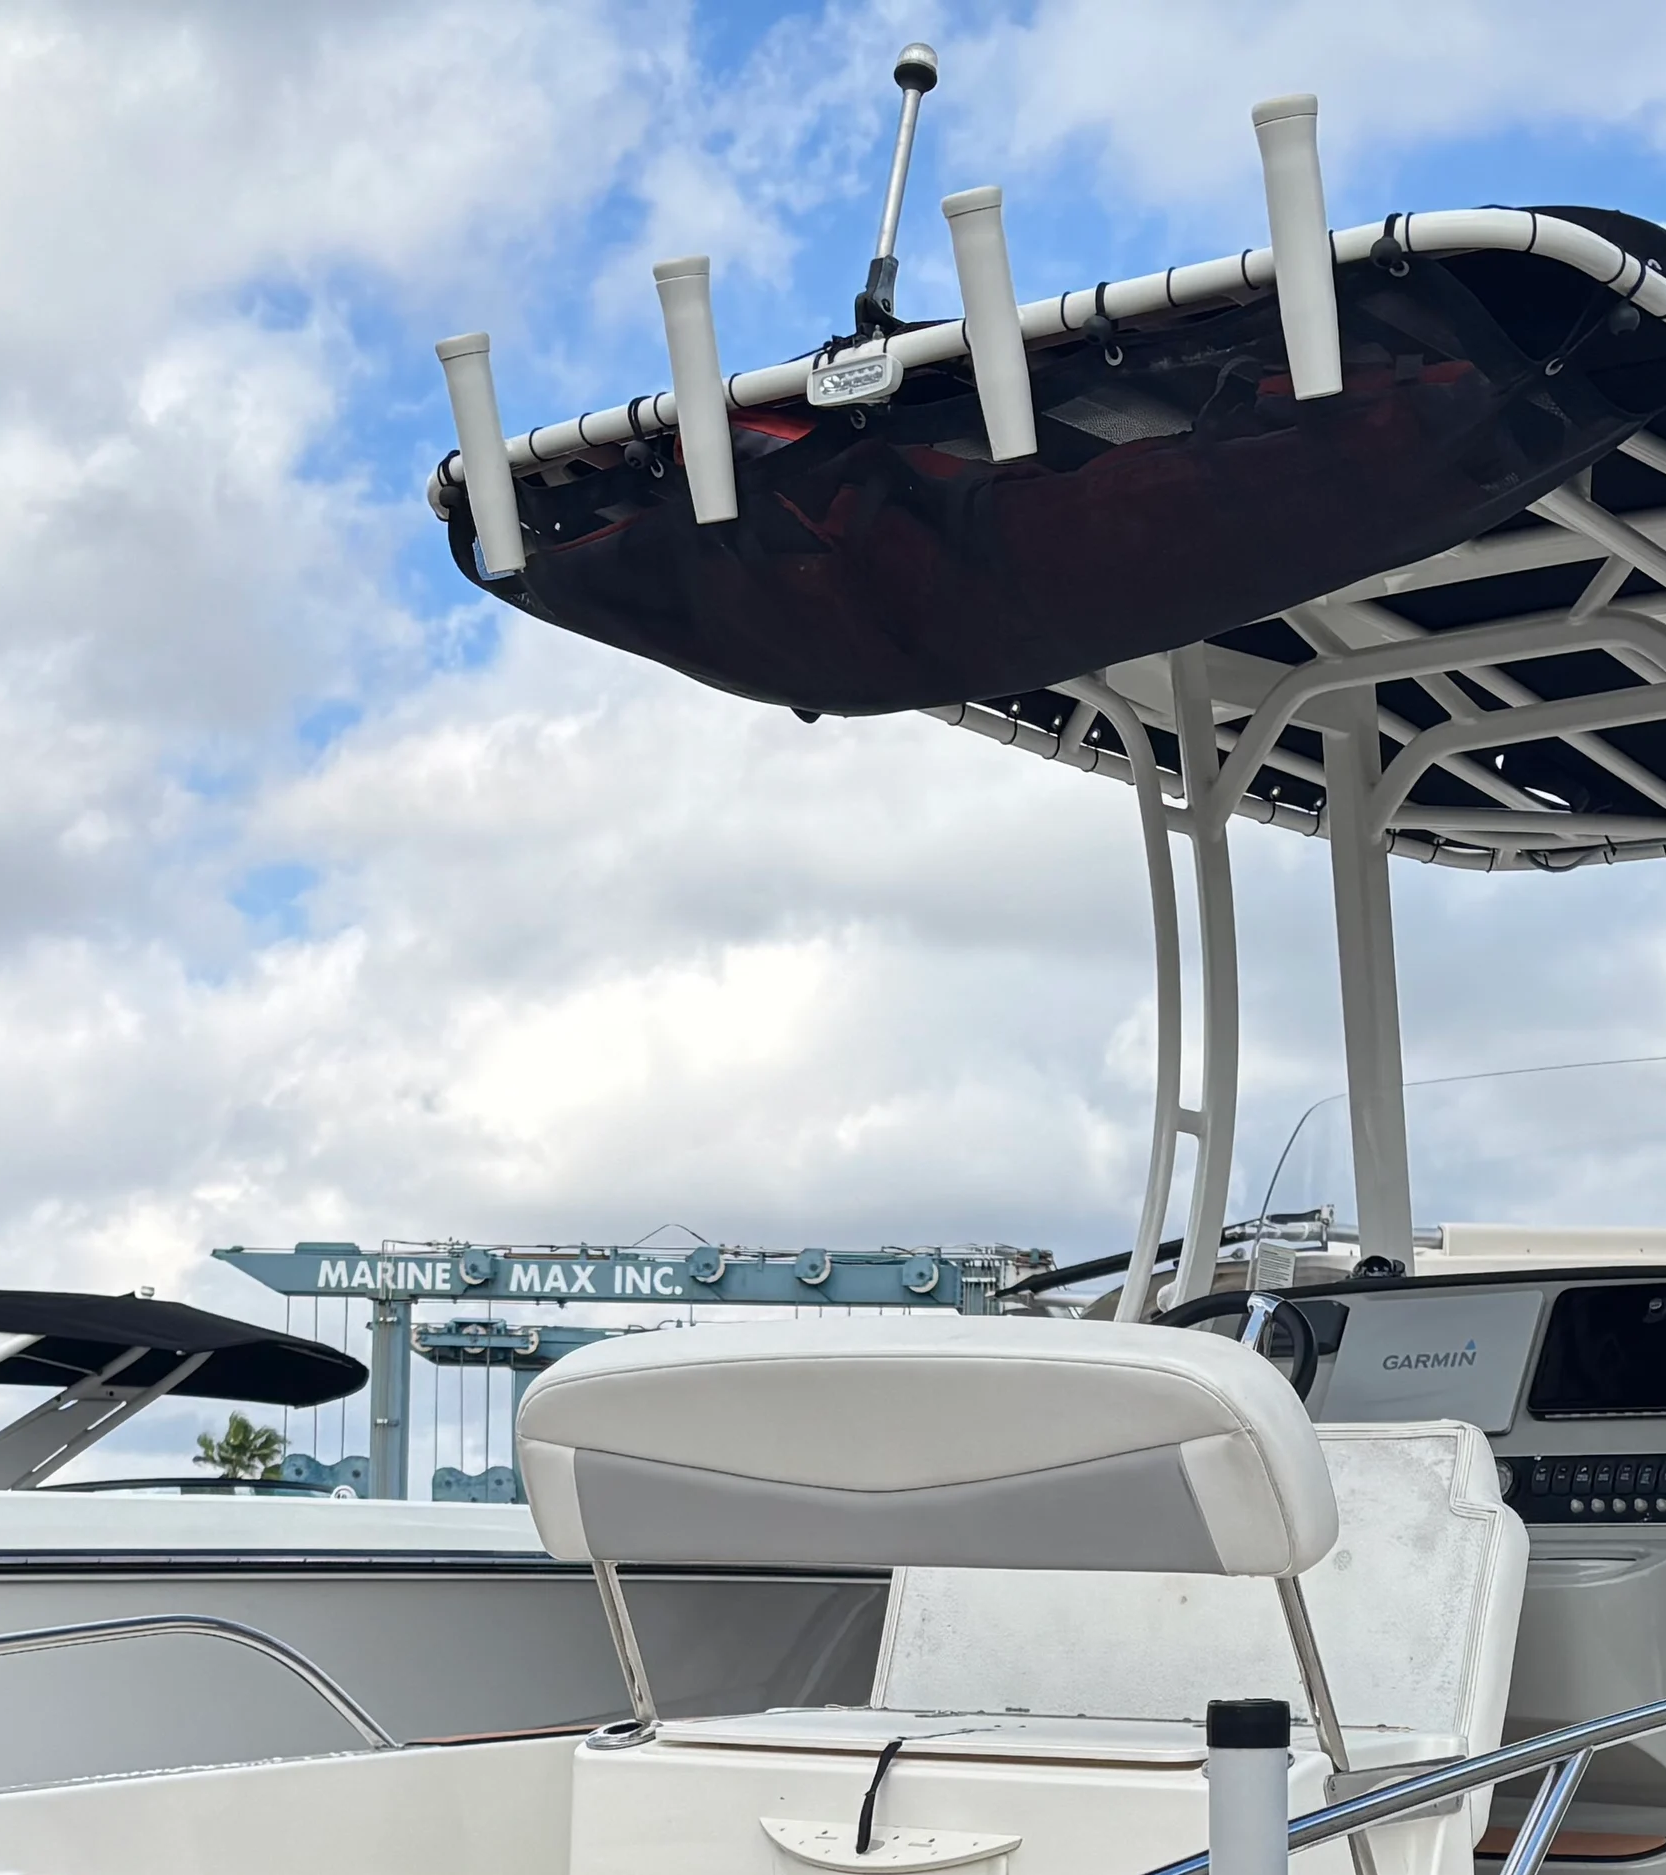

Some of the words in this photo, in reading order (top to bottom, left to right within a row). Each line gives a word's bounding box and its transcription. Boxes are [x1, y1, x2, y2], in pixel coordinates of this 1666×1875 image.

[317, 1257, 452, 1294] MARINE
[509, 1262, 597, 1294] MAX
[614, 1264, 684, 1297] INC.
[1382, 1350, 1477, 1371] GARMIN
